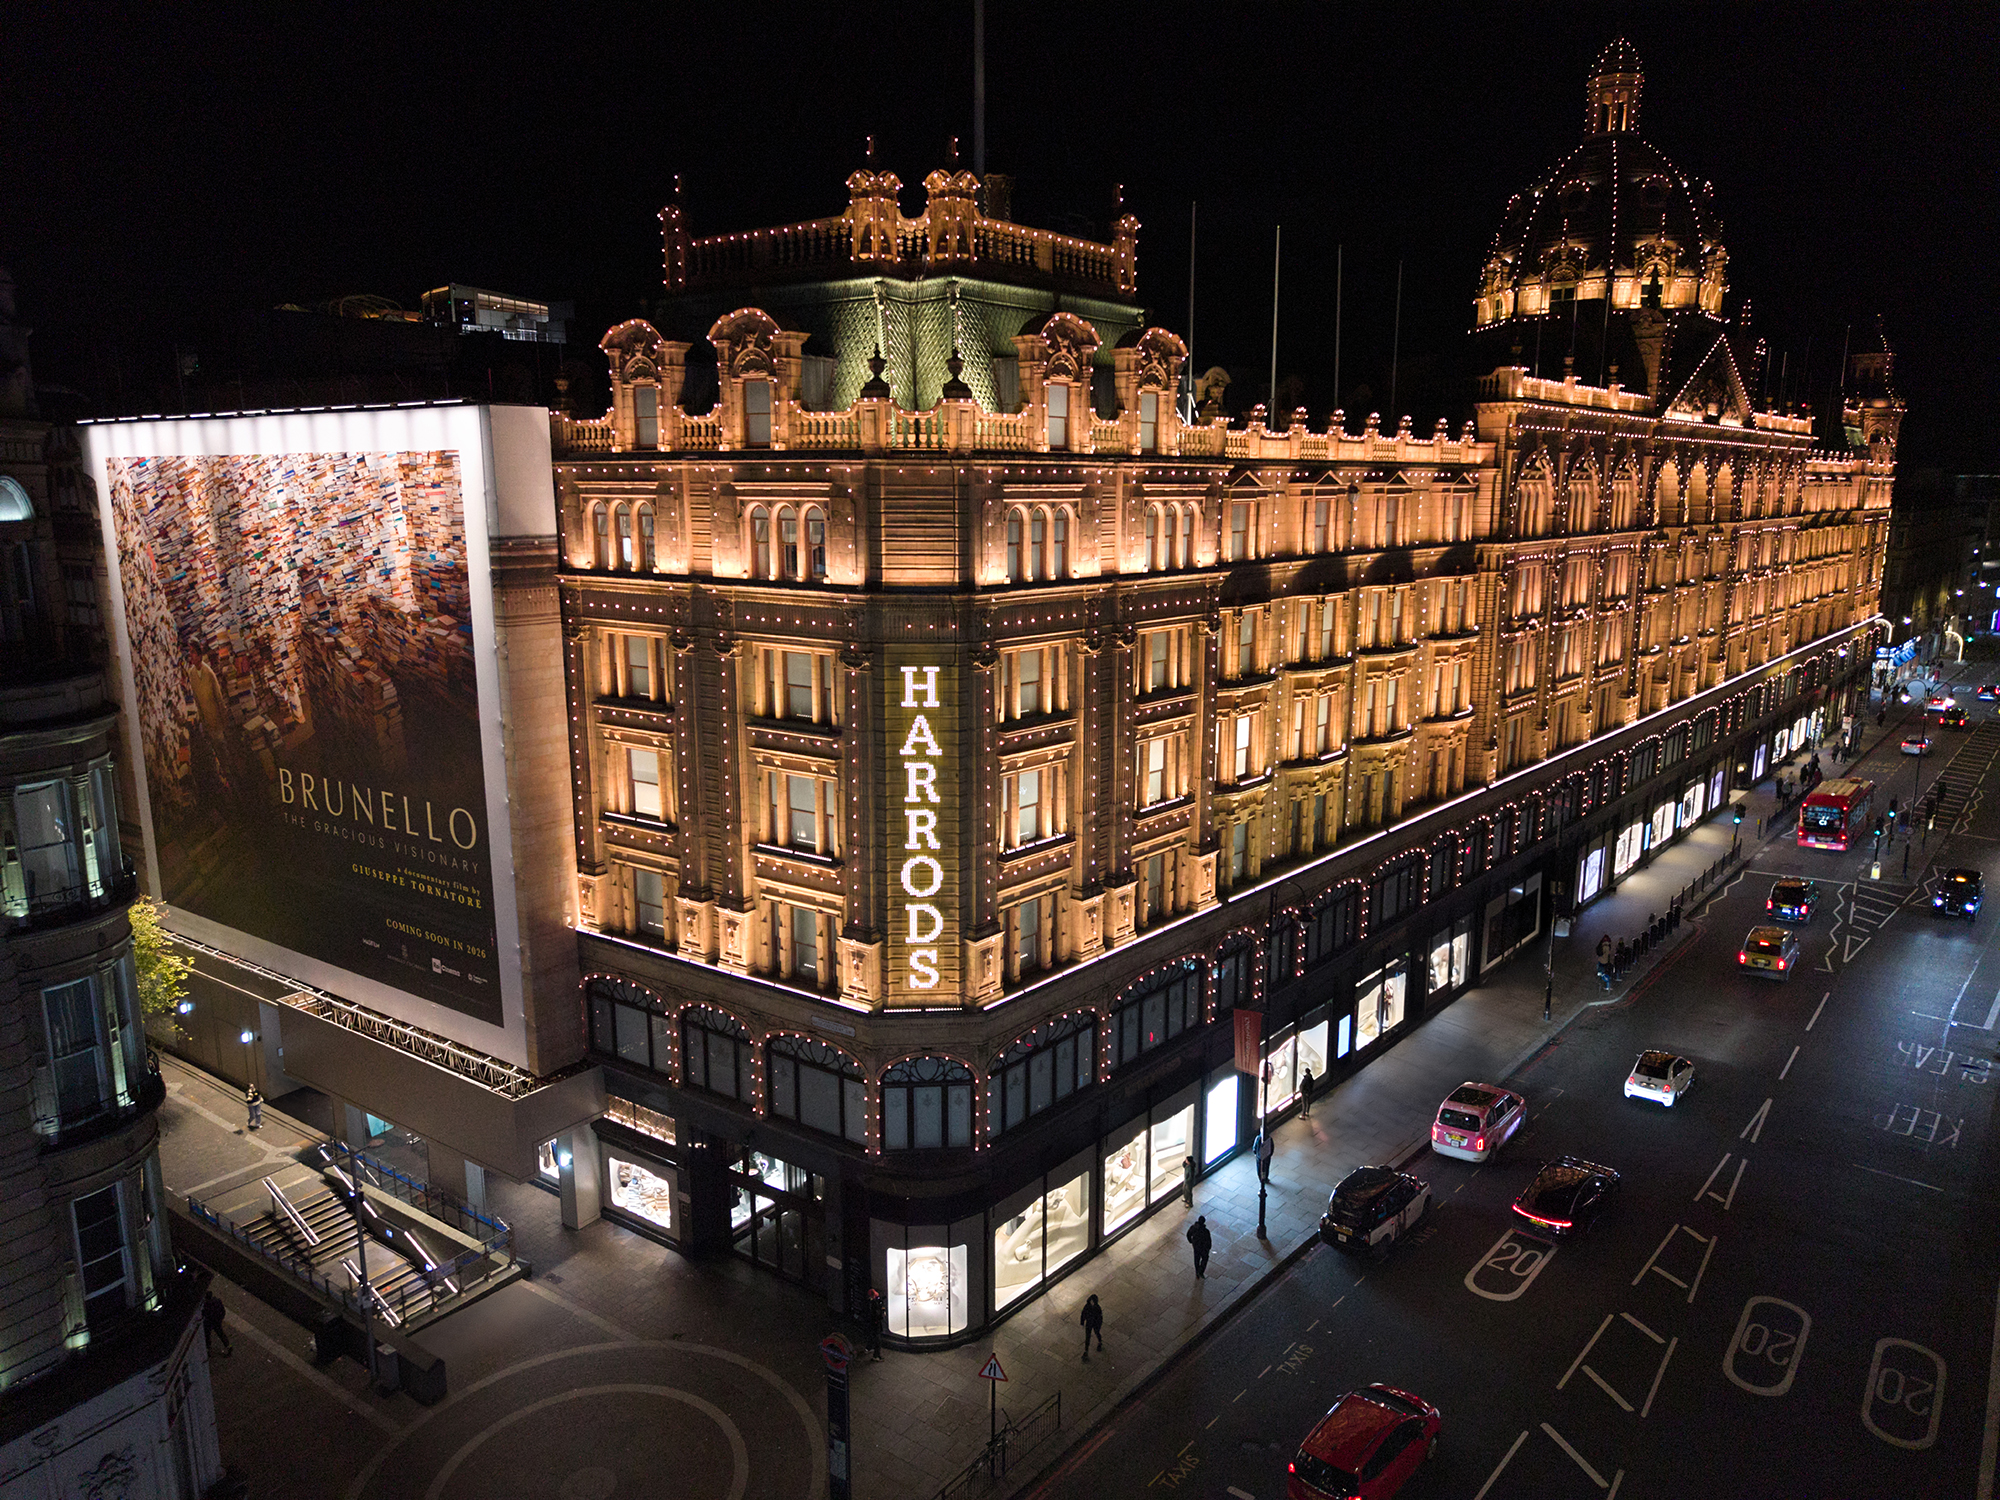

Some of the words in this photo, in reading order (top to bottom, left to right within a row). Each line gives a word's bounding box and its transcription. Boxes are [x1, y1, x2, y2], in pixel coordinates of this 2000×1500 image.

[279, 768, 477, 850] BRUNELLO
[900, 666, 944, 989] HARRODS
[284, 812, 306, 828] THE
[314, 820, 384, 849] GRACIOUS
[394, 841, 478, 874] VISIONARY
[352, 863, 406, 887] GIUSEPPE
[410, 879, 482, 909] TORNATORE
[404, 867, 451, 889] documentary
[453, 881, 469, 893] film
[471, 886, 481, 897] by
[386, 918, 422, 938] COMING
[424, 931, 450, 947] SOON
[453, 939, 463, 951] IN
[466, 944, 487, 959] 2026
[1874, 1102, 1965, 1149] KEEP
[1486, 1242, 1544, 1277] 20
[1276, 1343, 1314, 1375] TAXIS
[1740, 1323, 1797, 1366] 20
[1875, 1367, 1935, 1416] 20
[1159, 1454, 1200, 1489] TAXIS
